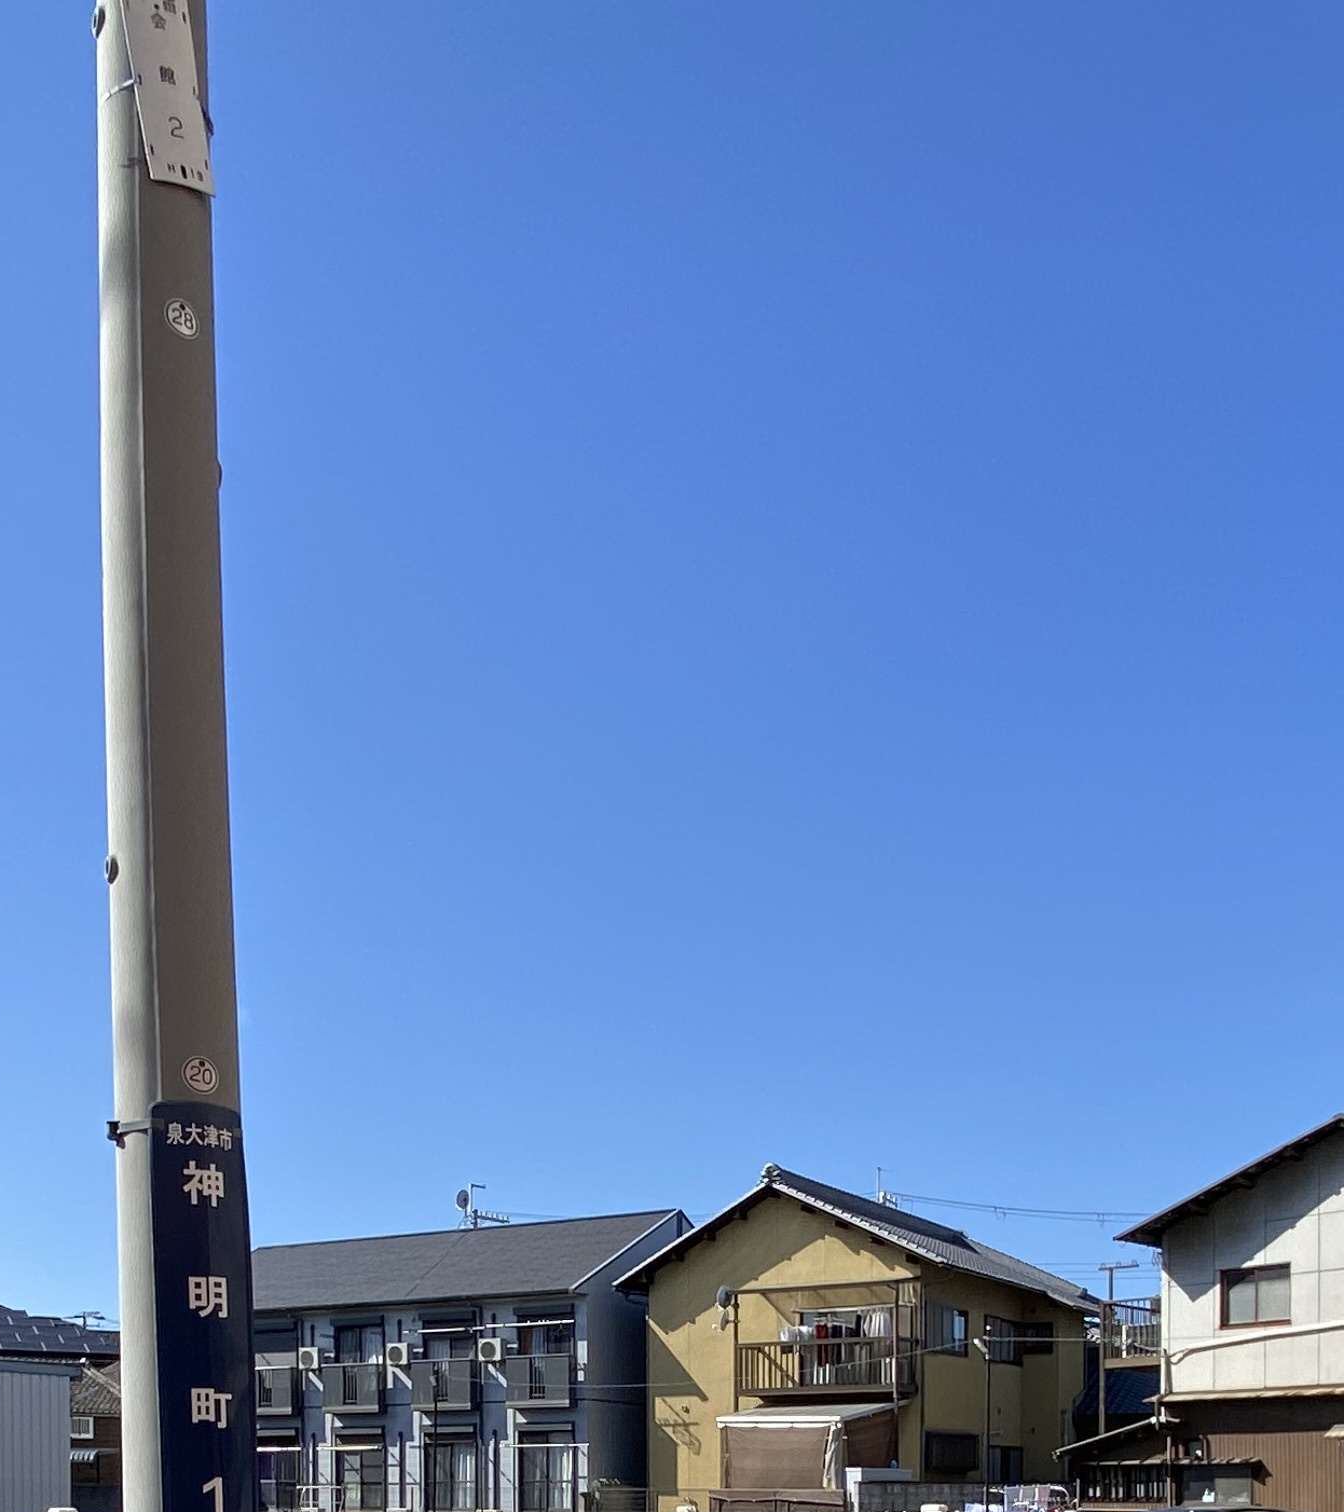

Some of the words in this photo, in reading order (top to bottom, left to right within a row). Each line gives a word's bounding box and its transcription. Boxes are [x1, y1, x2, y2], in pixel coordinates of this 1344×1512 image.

[171, 307, 194, 330] 28
[189, 1065, 213, 1085] 20
[166, 1122, 233, 1152] 泉大津市
